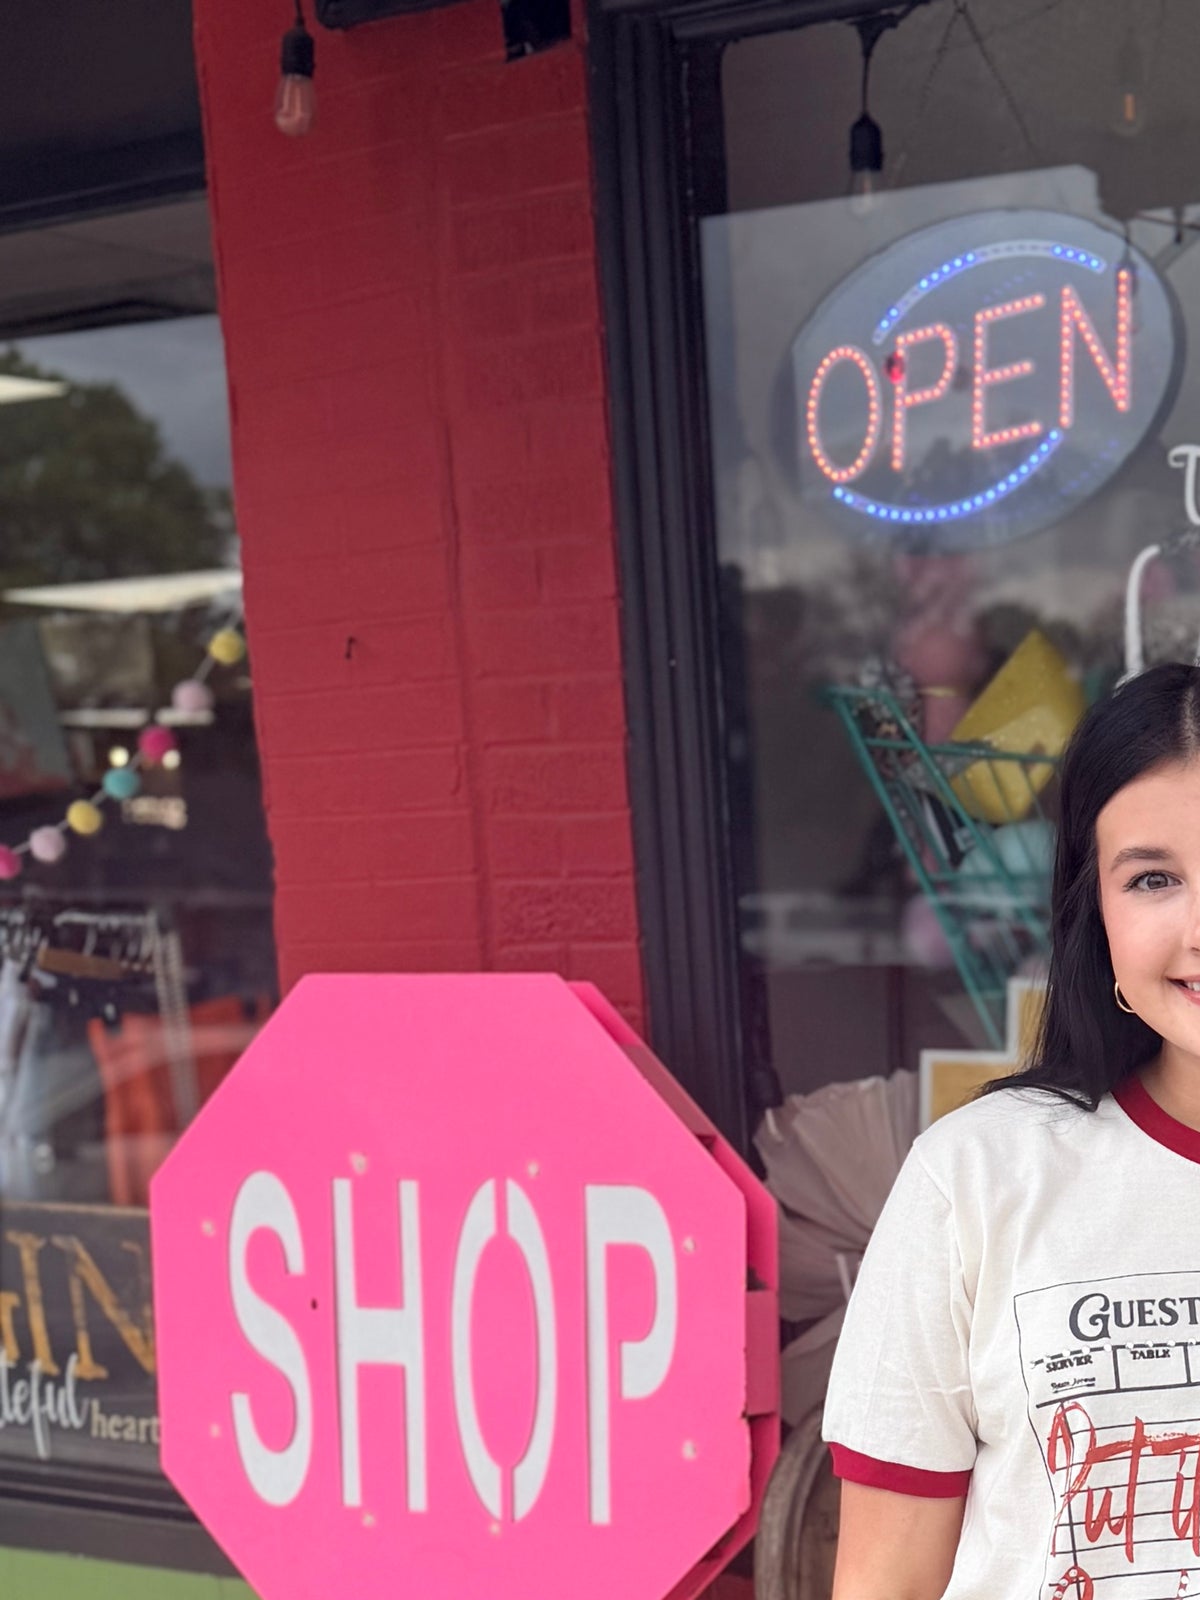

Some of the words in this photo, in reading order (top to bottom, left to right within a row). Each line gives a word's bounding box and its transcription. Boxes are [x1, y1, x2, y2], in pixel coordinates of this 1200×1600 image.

[807, 268, 1130, 483] OPEN
[0, 1231, 156, 1380] IN
[228, 1170, 678, 1525] SHOP
[1045, 1354, 1093, 1374] SERVER
[1130, 1349, 1171, 1361] TABLE
[1047, 1402, 1148, 1564] Put
